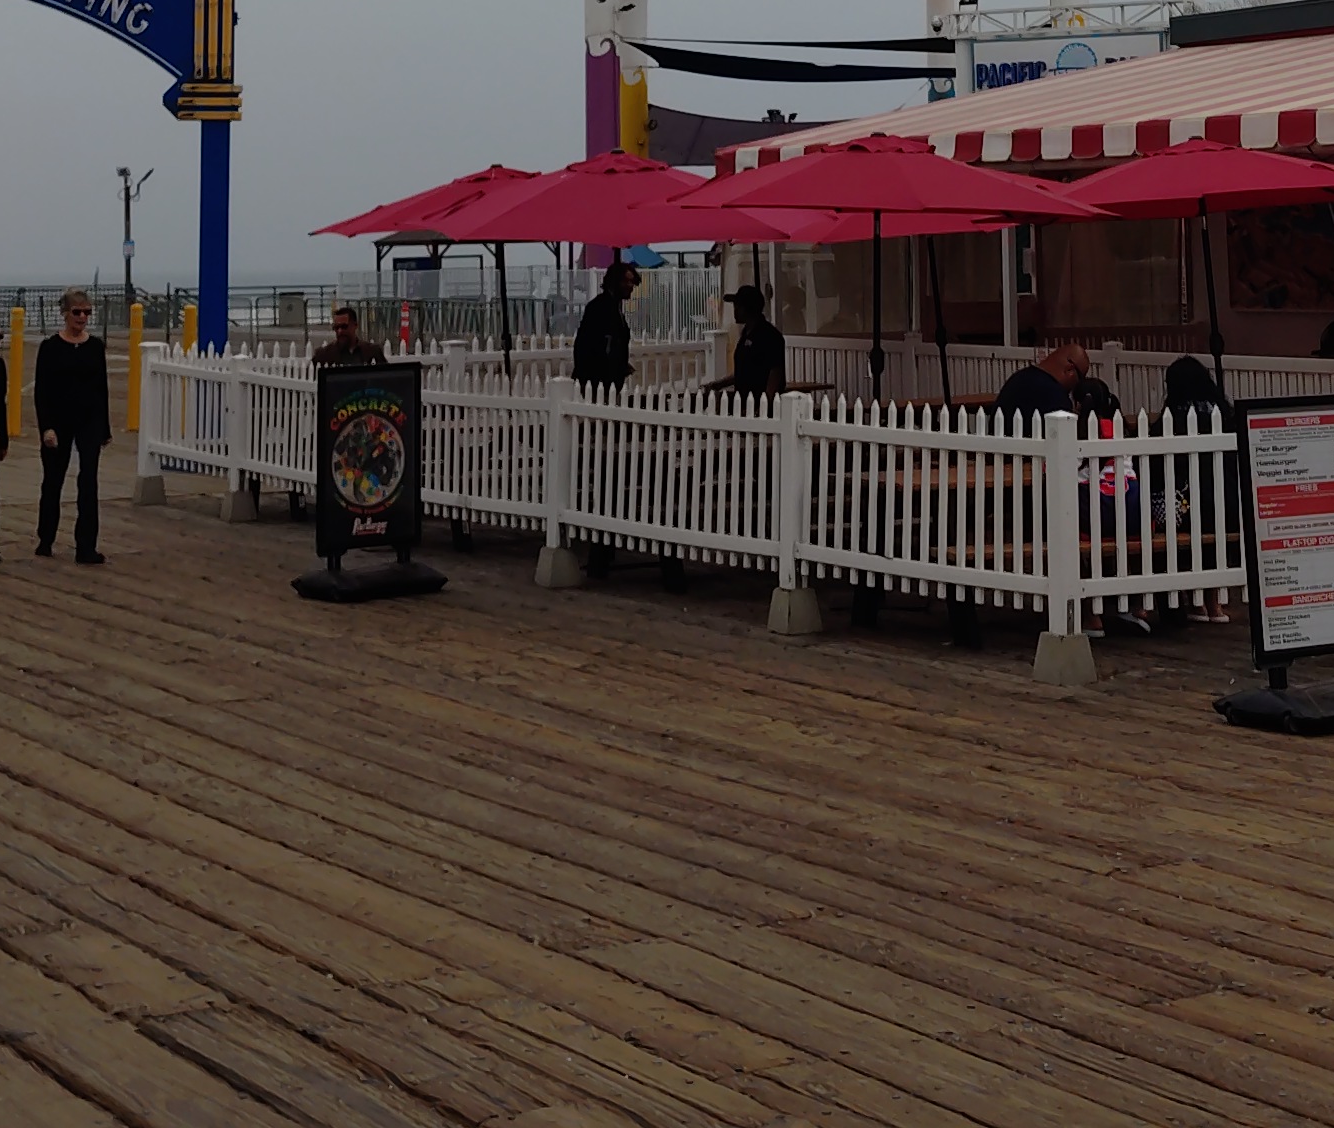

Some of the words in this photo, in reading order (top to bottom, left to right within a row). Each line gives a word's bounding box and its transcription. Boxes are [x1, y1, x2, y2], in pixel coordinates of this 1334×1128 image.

[975, 60, 1048, 90] PACIFIC
[1271, 444, 1298, 453] Burger
[1256, 458, 1298, 467] Hamburger
[1257, 469, 1282, 478] Veggie
[1283, 468, 1310, 477] Burger
